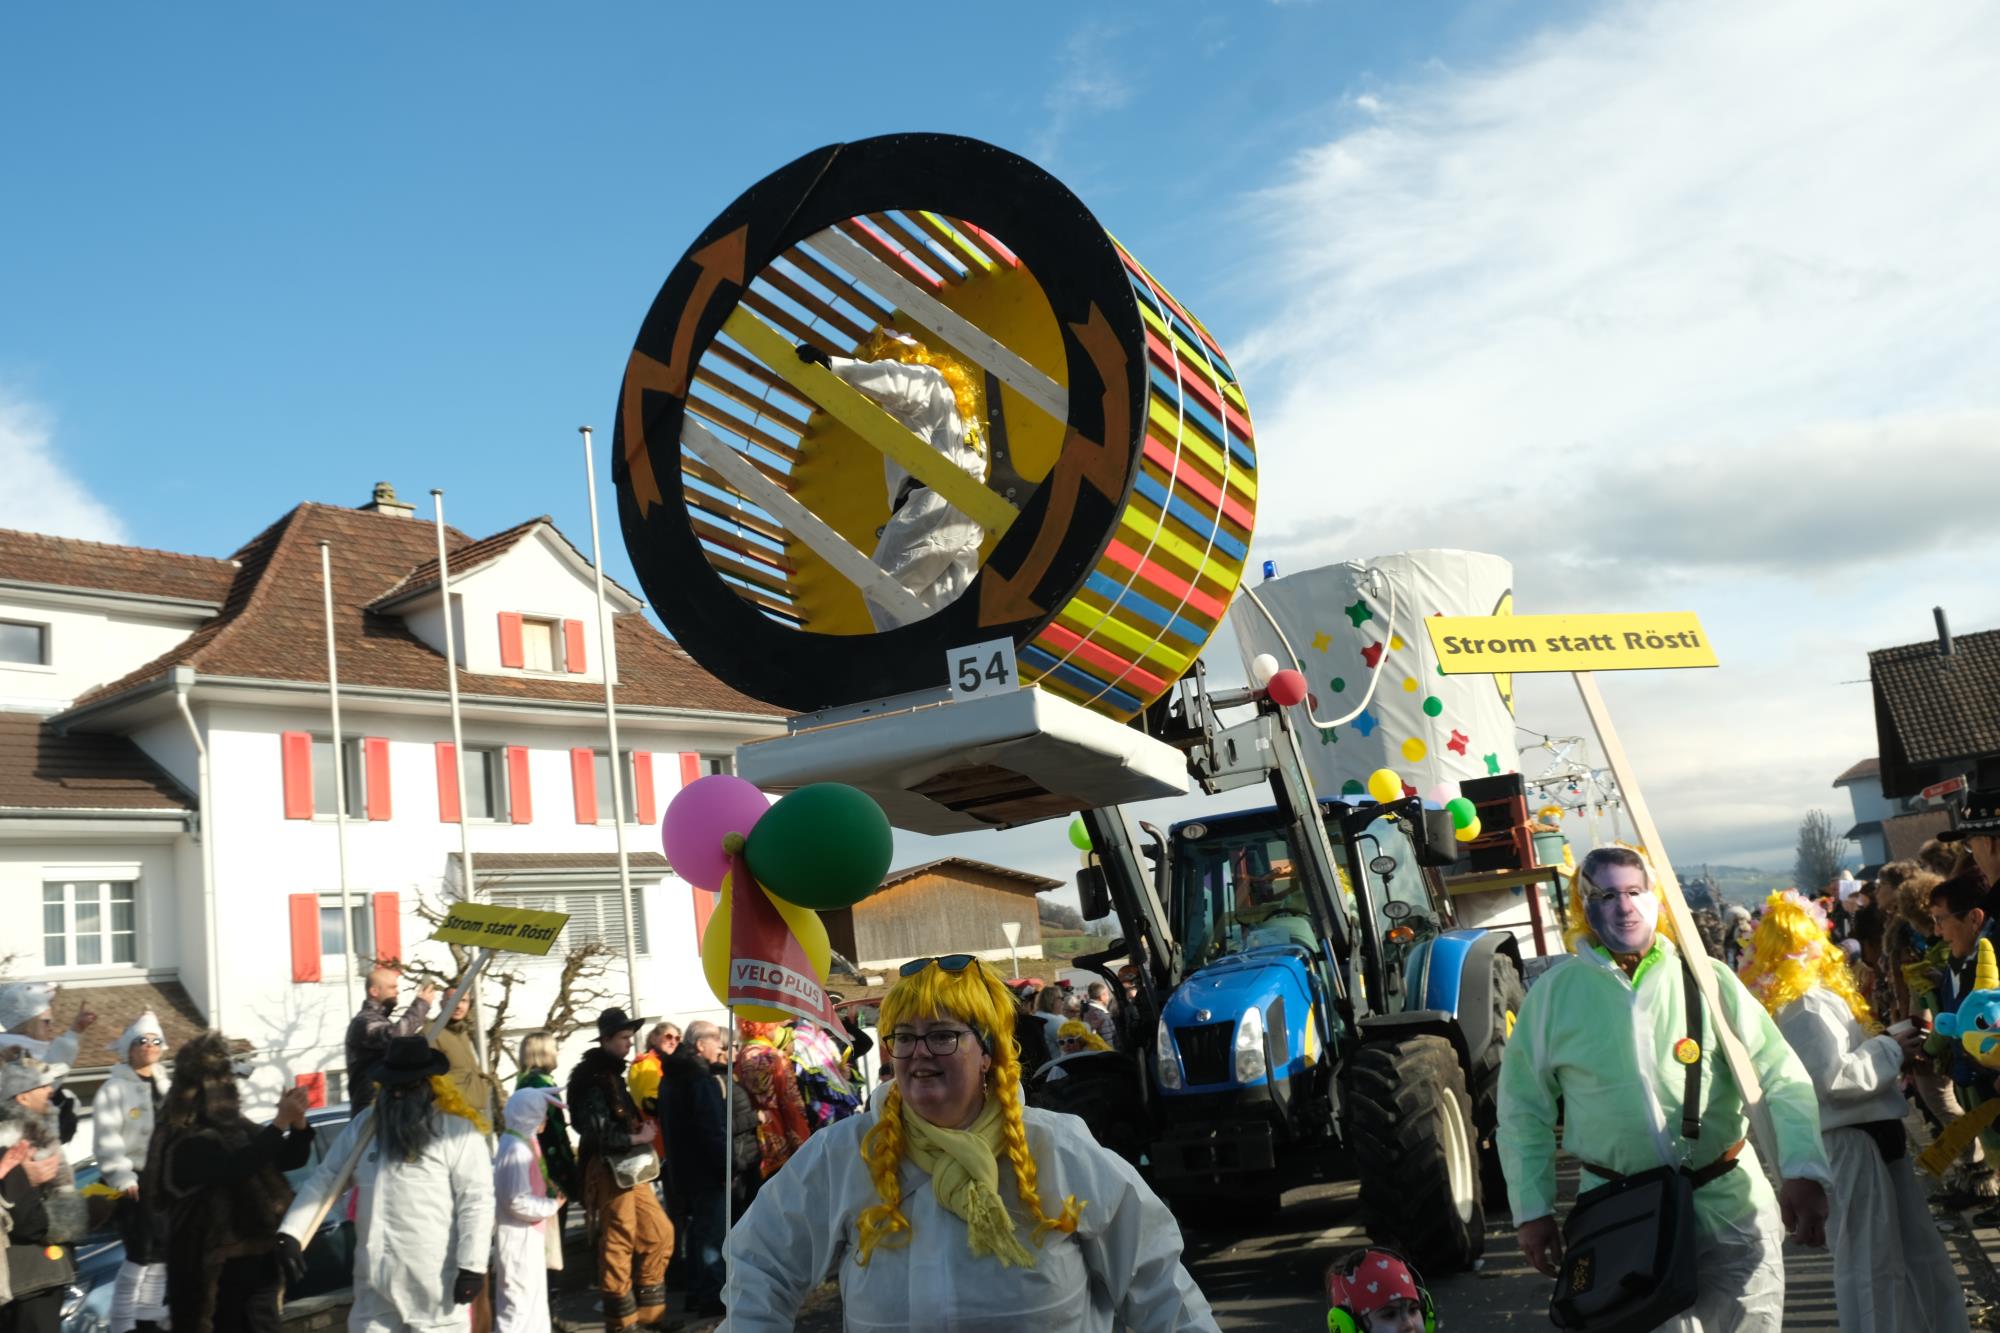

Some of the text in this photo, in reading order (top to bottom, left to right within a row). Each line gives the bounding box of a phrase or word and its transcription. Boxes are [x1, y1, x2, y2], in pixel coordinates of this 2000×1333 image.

[1442, 630, 1701, 655] Strom statt Rösti
[958, 650, 1009, 692] 54
[443, 915, 557, 940] Strom statt Rösti
[736, 964, 820, 1003] VELOPLUS
